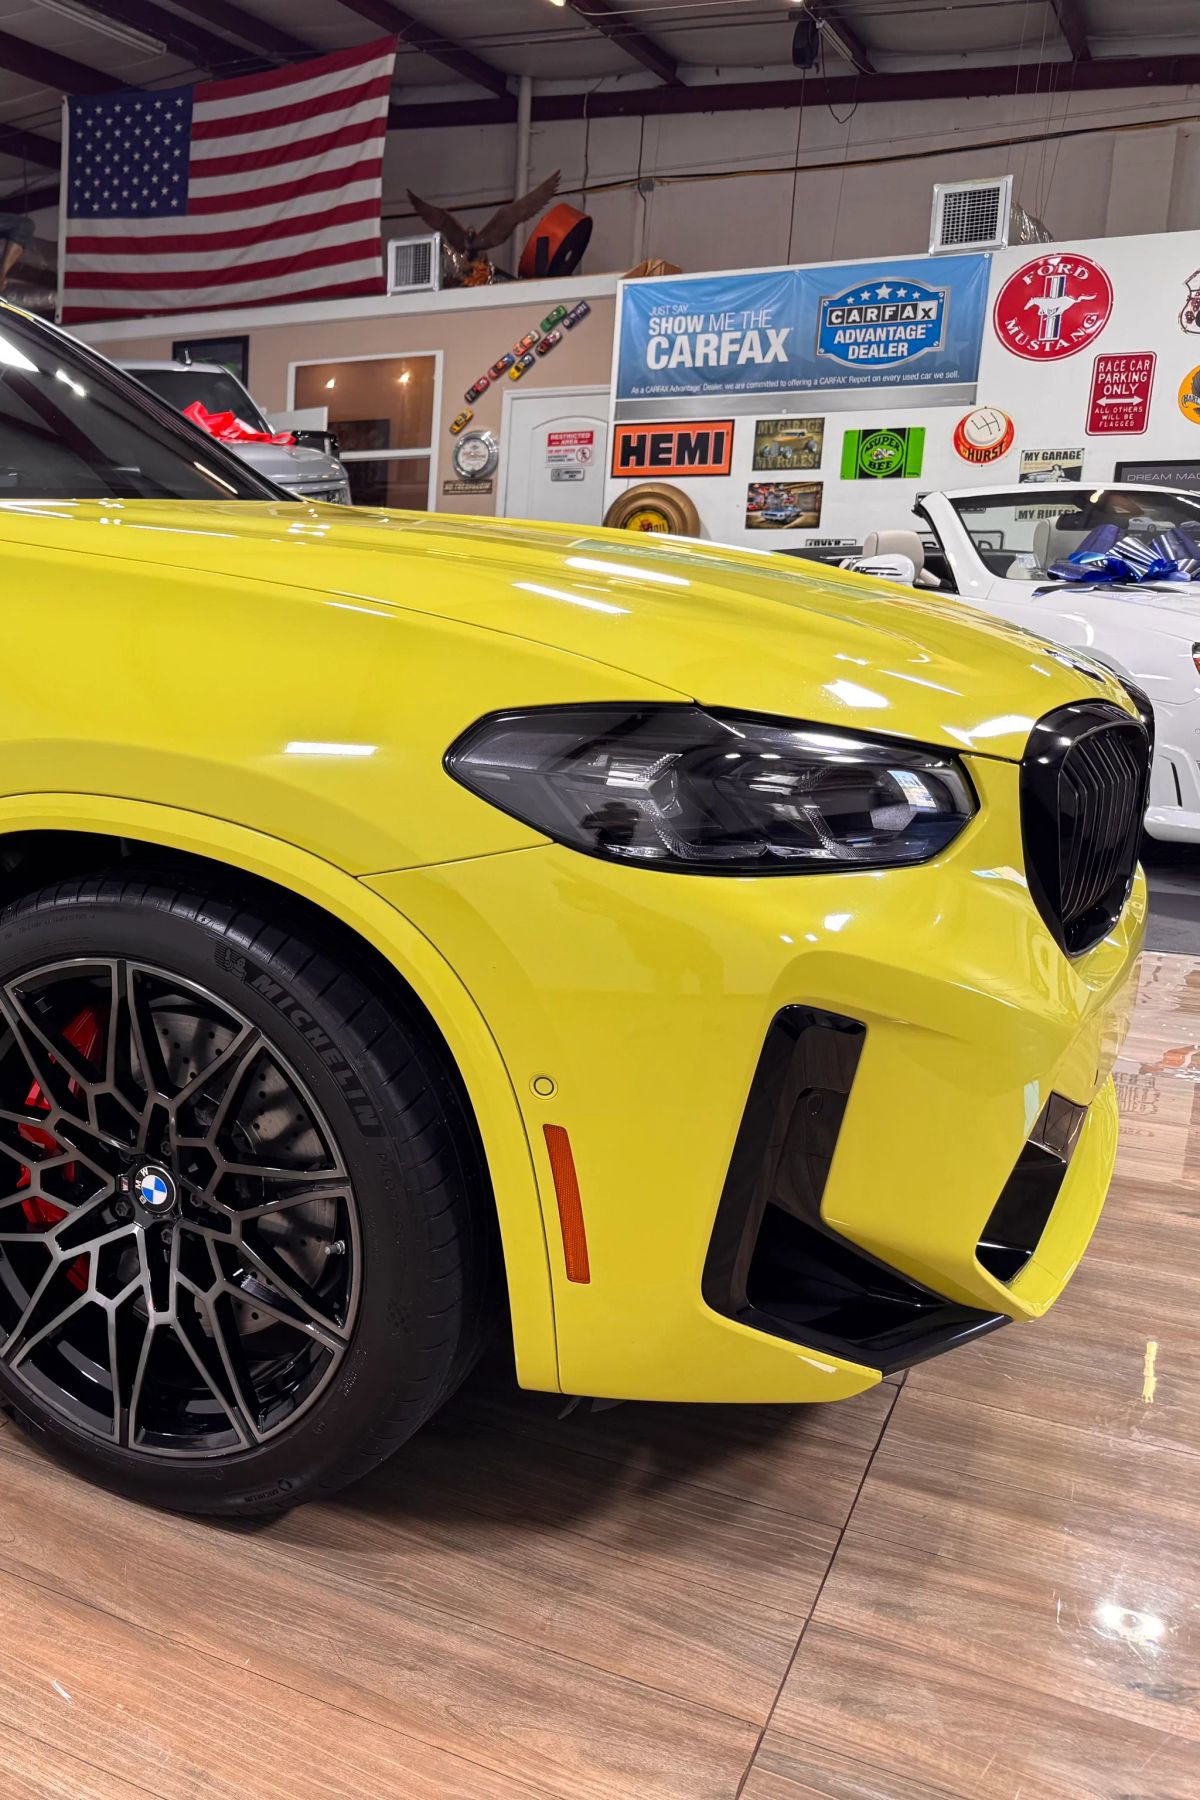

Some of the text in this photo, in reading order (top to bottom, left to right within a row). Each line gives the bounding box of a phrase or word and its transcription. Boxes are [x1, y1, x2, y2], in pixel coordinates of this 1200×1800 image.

[1022, 263, 1089, 285] FORD
[649, 304, 688, 316] JUST SAY
[830, 303, 933, 324] CARFAX
[649, 309, 773, 335] SHOW ME THE
[834, 325, 926, 344] ADVANTAGE
[1005, 312, 1098, 351] MUSTANG
[647, 327, 790, 370] CARFAX
[848, 342, 908, 360] DEALER
[1098, 359, 1150, 373] RACE CAR
[746, 380, 778, 389] committed
[779, 379, 787, 387] to
[788, 378, 812, 388] offering
[849, 375, 871, 385] Report
[882, 375, 900, 383] every
[902, 372, 919, 381] used
[1098, 372, 1148, 384] PARKING
[1103, 383, 1139, 395] ONLY
[1094, 406, 1143, 414] ALL OTHERS
[758, 419, 822, 434] MY GARAGE
[1098, 420, 1135, 428] FLAGGED
[620, 430, 726, 468] HEMI
[865, 436, 901, 452] SUPER
[967, 443, 1005, 461] HURST
[1024, 450, 1082, 461] MY GARAGE
[755, 456, 776, 468] MY
[867, 460, 893, 470] BEE
[1127, 473, 1172, 482] DREAM
[1018, 509, 1035, 520] MY
[251, 973, 380, 1126] MICHELIN
